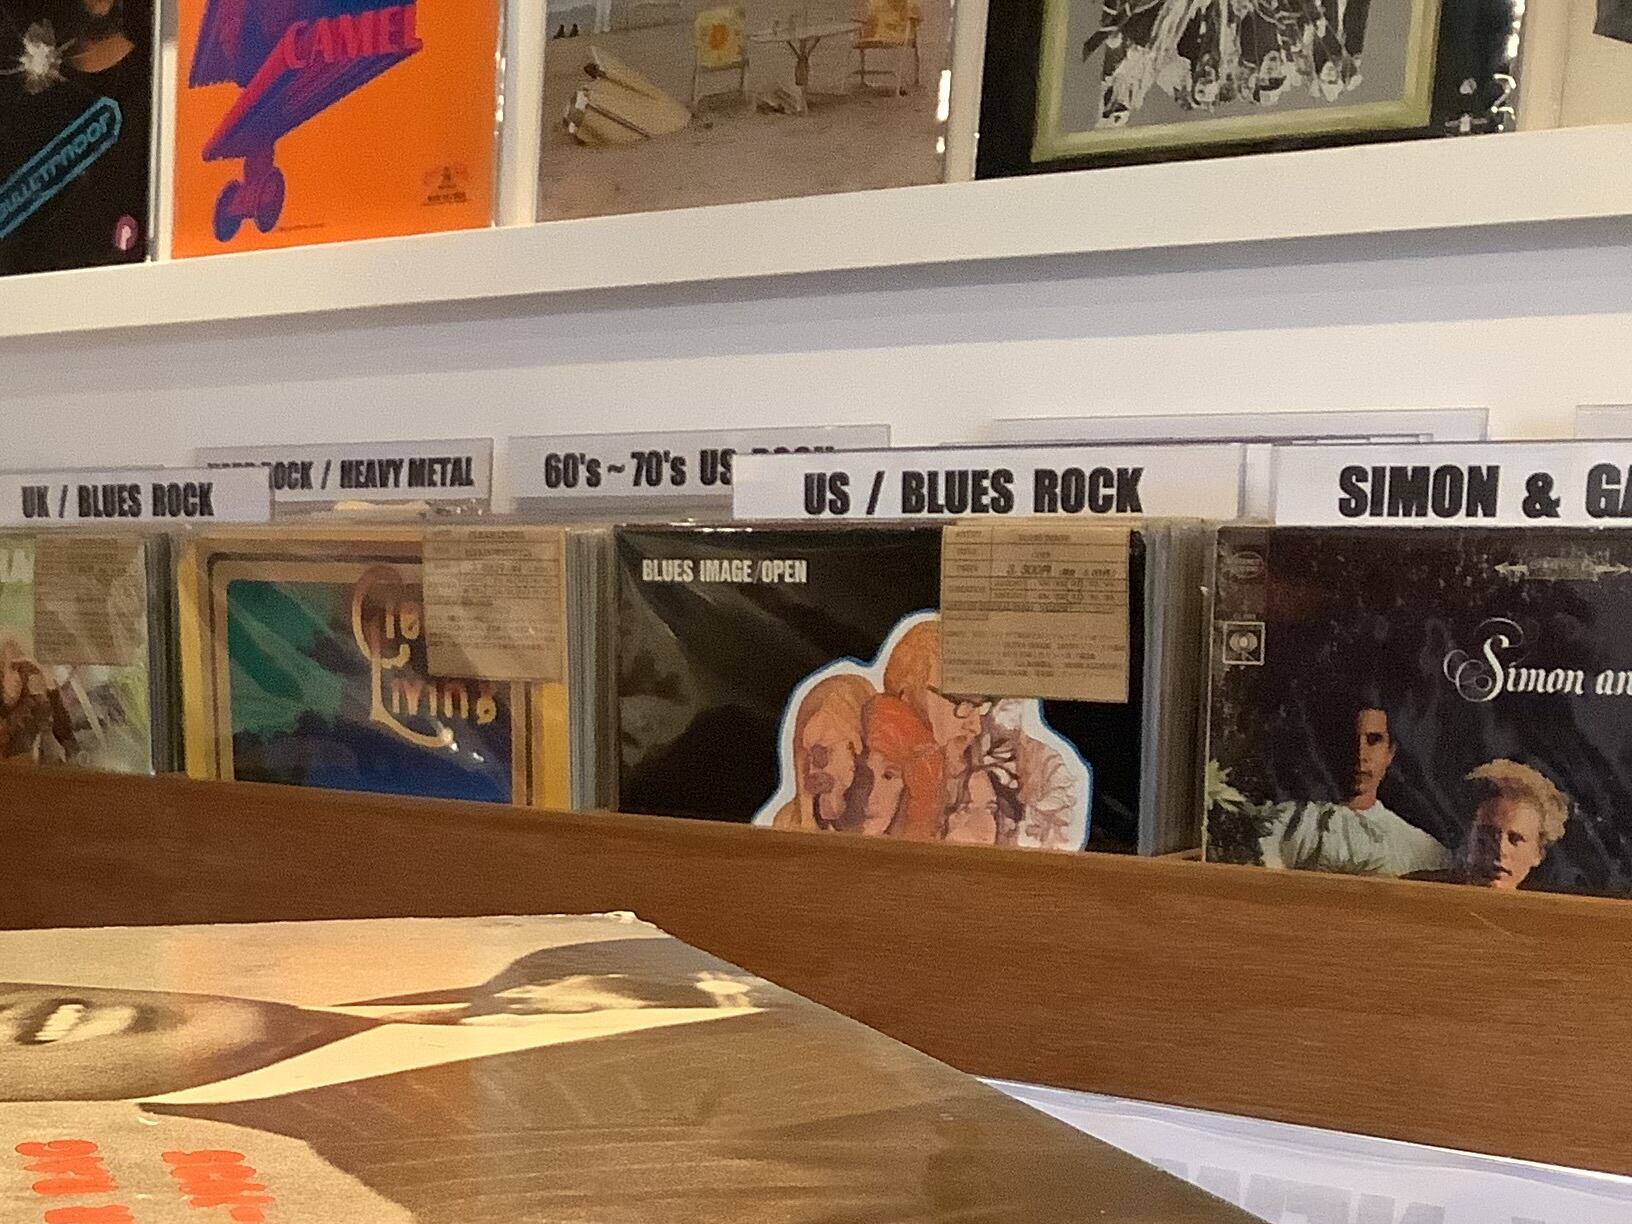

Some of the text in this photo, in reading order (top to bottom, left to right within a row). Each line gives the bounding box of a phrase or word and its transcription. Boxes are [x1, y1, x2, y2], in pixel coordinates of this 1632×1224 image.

[283, 4, 423, 68] CAMEL
[339, 458, 404, 489] HEAVY
[408, 455, 474, 488] METAL
[803, 466, 1145, 516] US / BLUES ROCK
[1338, 464, 1501, 519] SIMON
[1521, 472, 1562, 519] &
[21, 485, 50, 519] UK
[77, 483, 143, 518] BLUES
[152, 481, 215, 518] ROCK
[641, 558, 695, 583] BLUES
[1443, 616, 1585, 703] Simon
[14, 1139, 118, 1197] RAG
